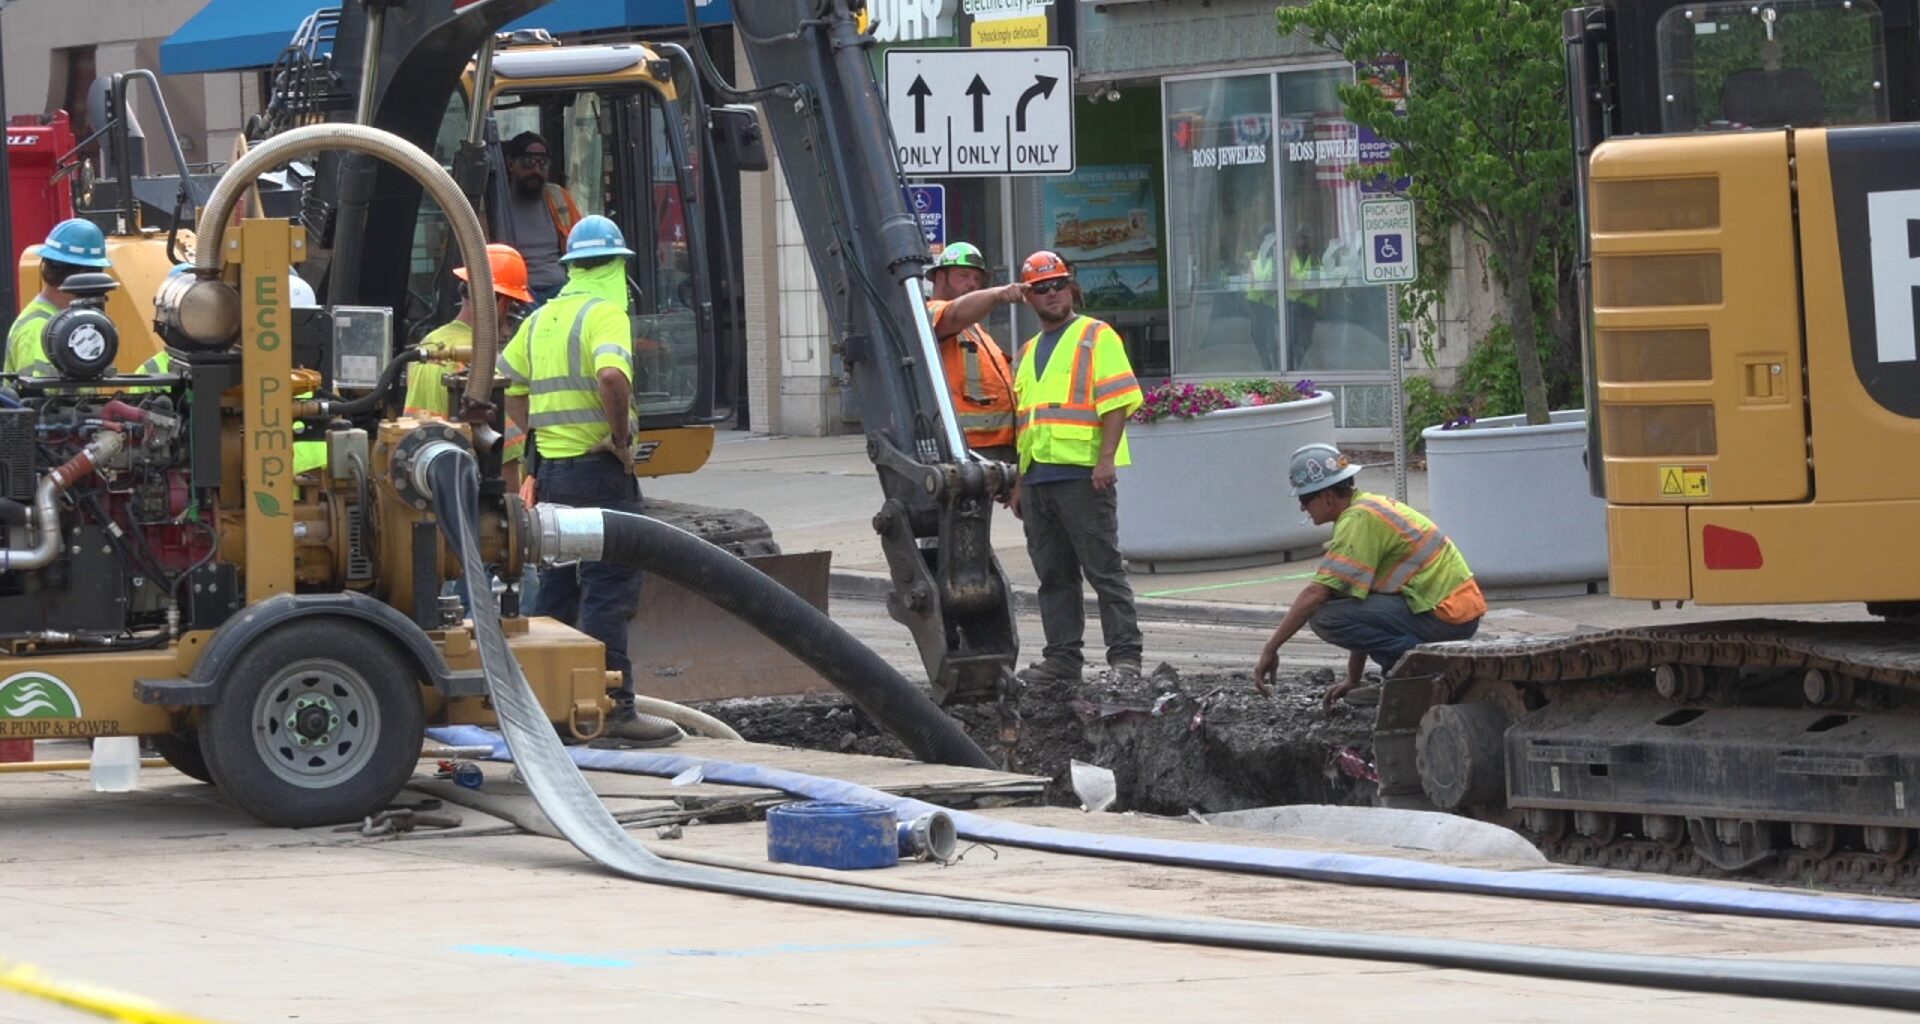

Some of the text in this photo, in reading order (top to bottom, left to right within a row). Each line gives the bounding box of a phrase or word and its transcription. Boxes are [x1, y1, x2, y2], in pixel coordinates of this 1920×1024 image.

[899, 145, 942, 165] ONLY
[957, 145, 1001, 165] ONLY
[1017, 144, 1059, 165] ONLY
[1192, 144, 1266, 170] ROSS JEWELERS
[1289, 141, 1315, 161] ROSS
[1366, 217, 1409, 230] DISCHARGE
[1373, 265, 1409, 279] ONLY
[11, 720, 50, 735] PUMP
[53, 720, 64, 735] &
[68, 719, 120, 735] POWER
